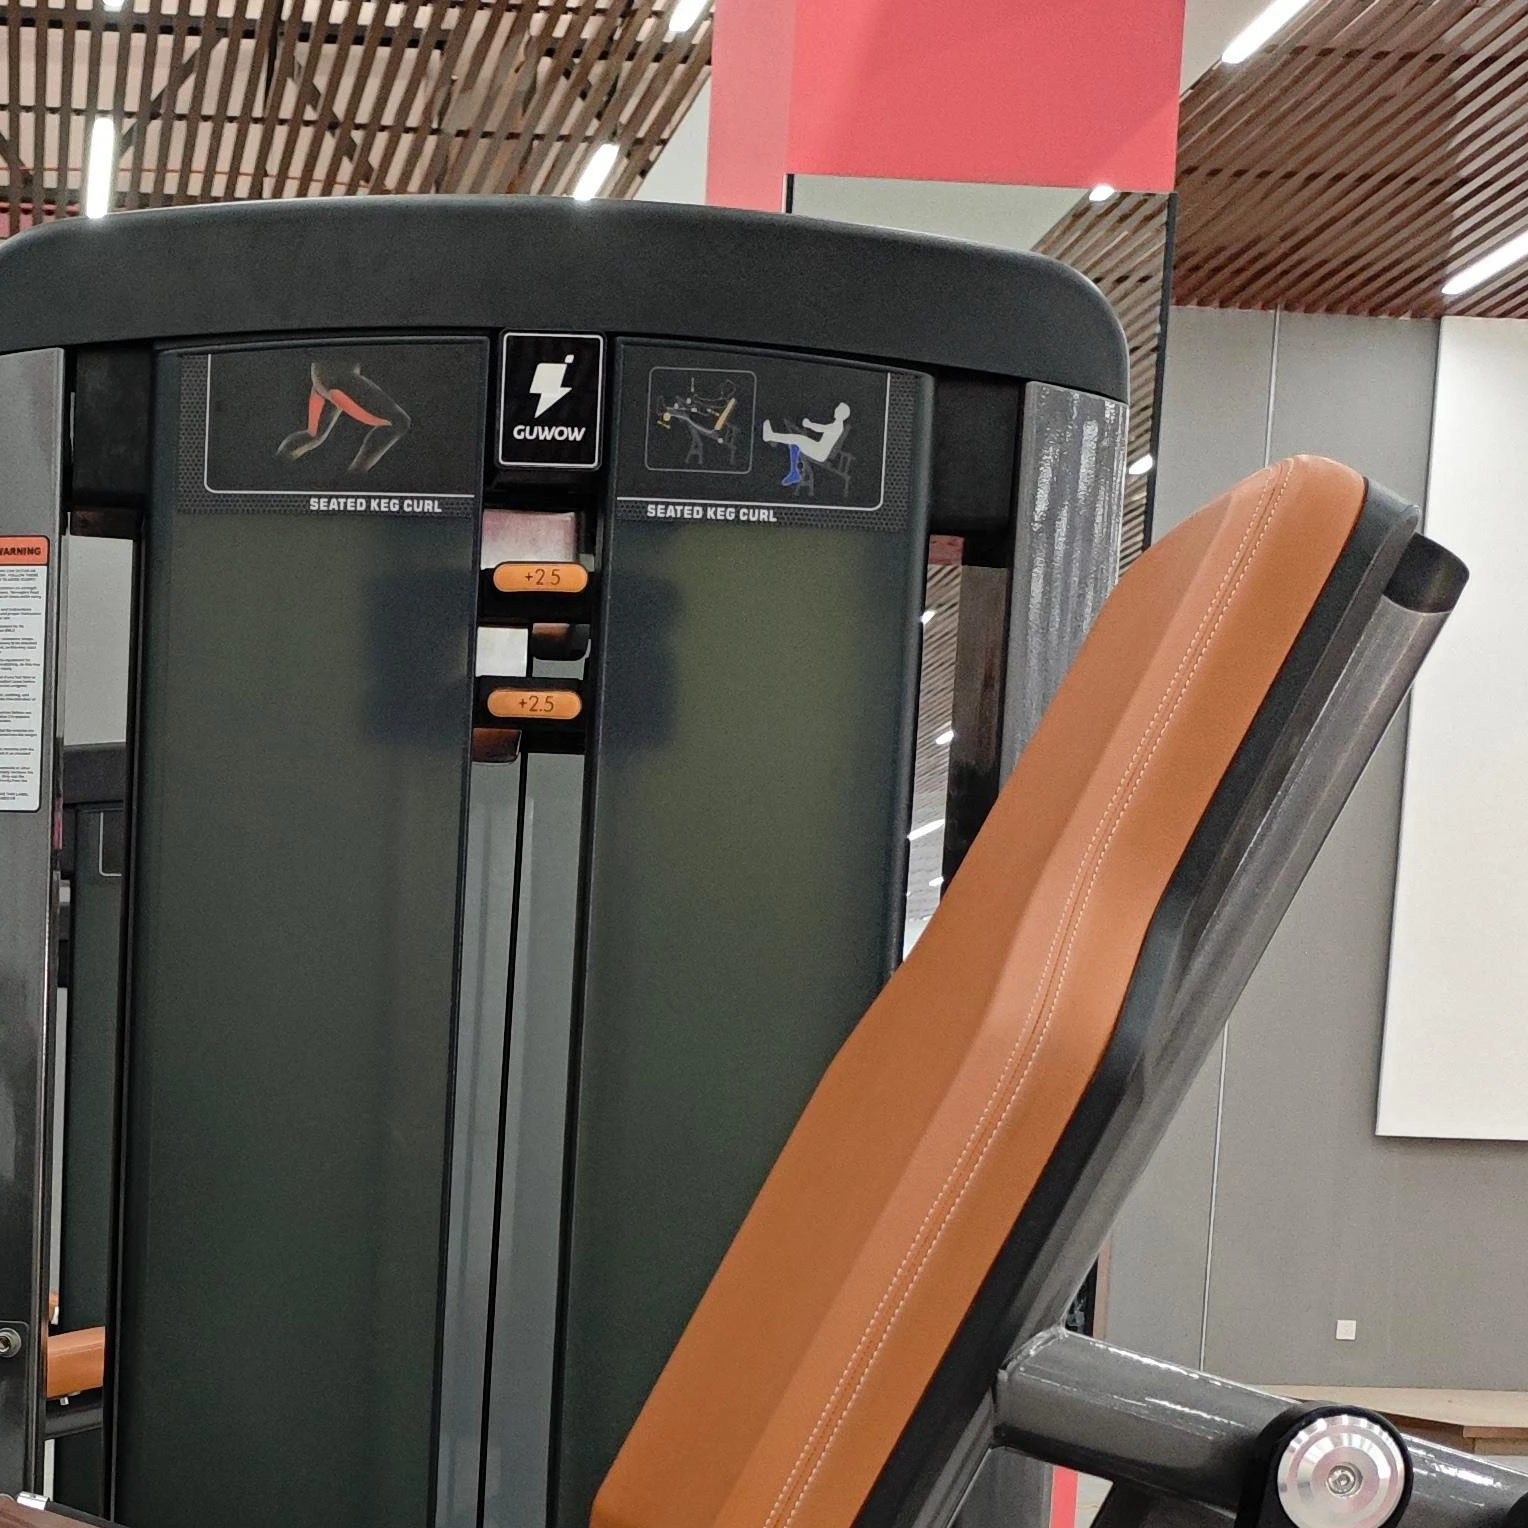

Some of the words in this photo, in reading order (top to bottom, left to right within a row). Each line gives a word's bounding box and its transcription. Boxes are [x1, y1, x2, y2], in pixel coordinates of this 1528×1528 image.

[513, 425, 585, 441] GUWOW
[310, 498, 366, 511] SEATED
[370, 499, 399, 511] KEG
[403, 499, 442, 512] CURL
[647, 504, 703, 518] SEATED
[707, 507, 735, 520] KEG
[739, 508, 777, 522] CURL
[519, 695, 555, 712] +2.5
